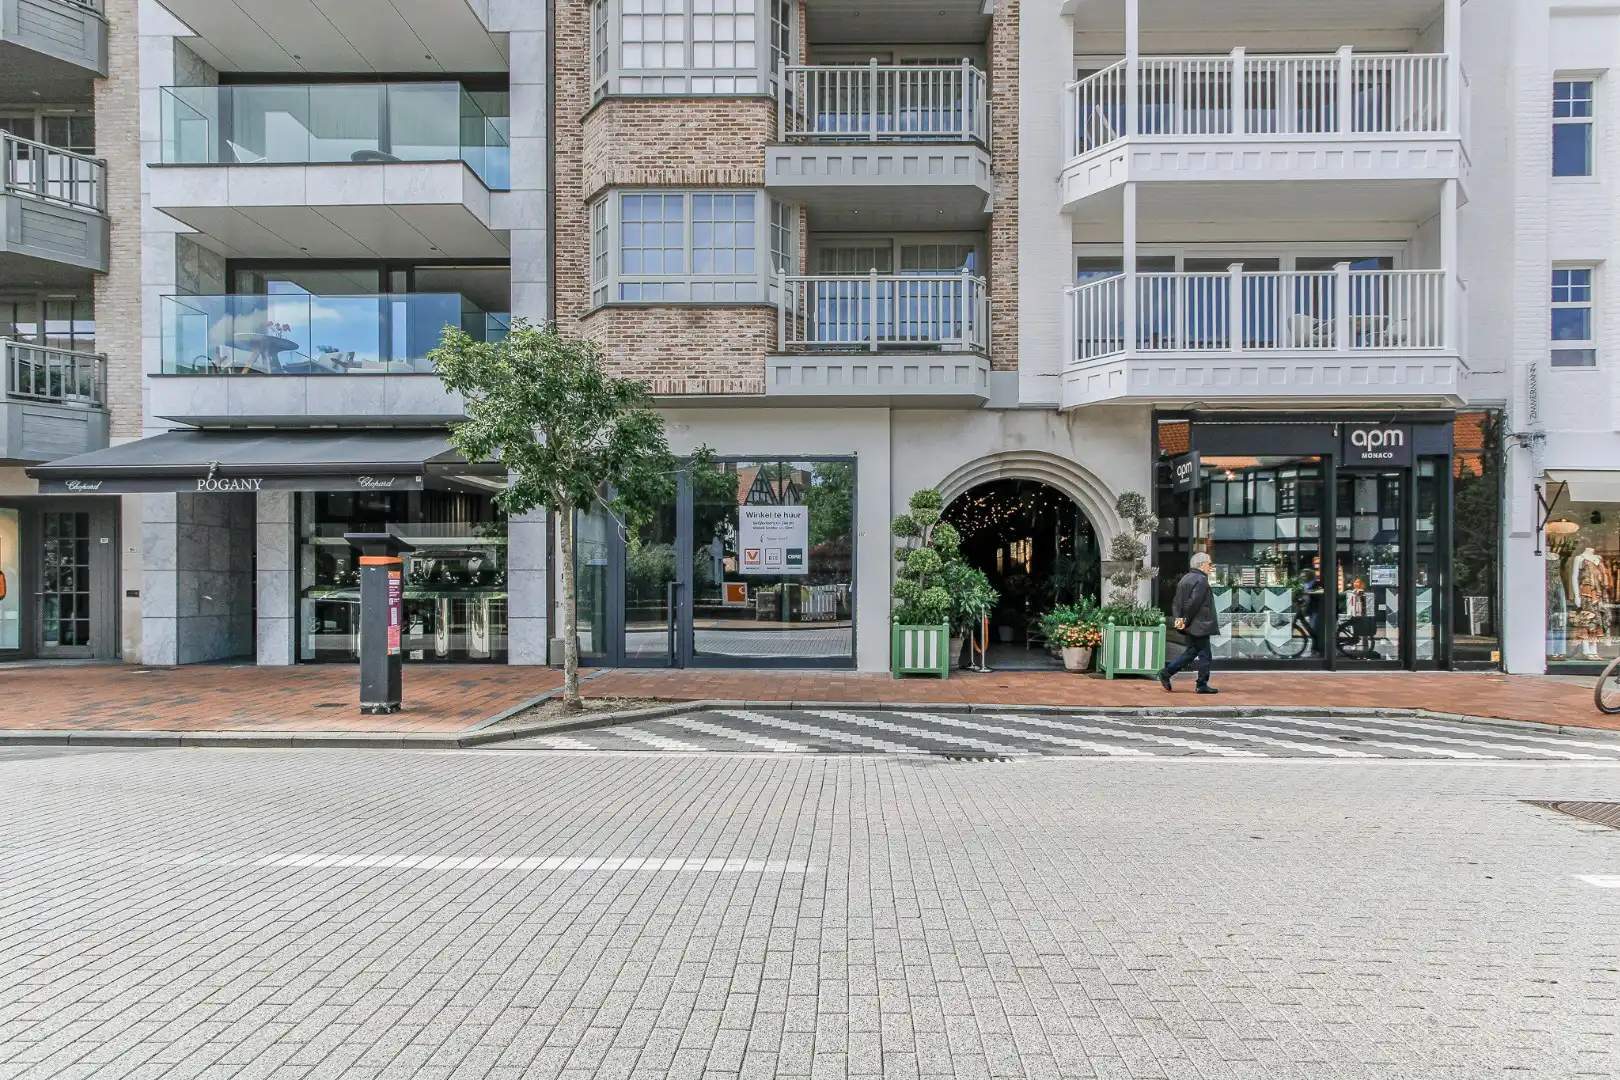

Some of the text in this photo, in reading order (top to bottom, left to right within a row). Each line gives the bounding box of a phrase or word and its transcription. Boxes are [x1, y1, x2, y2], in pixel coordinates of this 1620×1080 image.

[1351, 429, 1404, 451] apm
[1176, 461, 1193, 479] apm
[65, 480, 102, 492] Chopard
[196, 478, 263, 491] POGANY
[358, 476, 395, 489] Chopard
[745, 511, 801, 519] Winkel te huur
